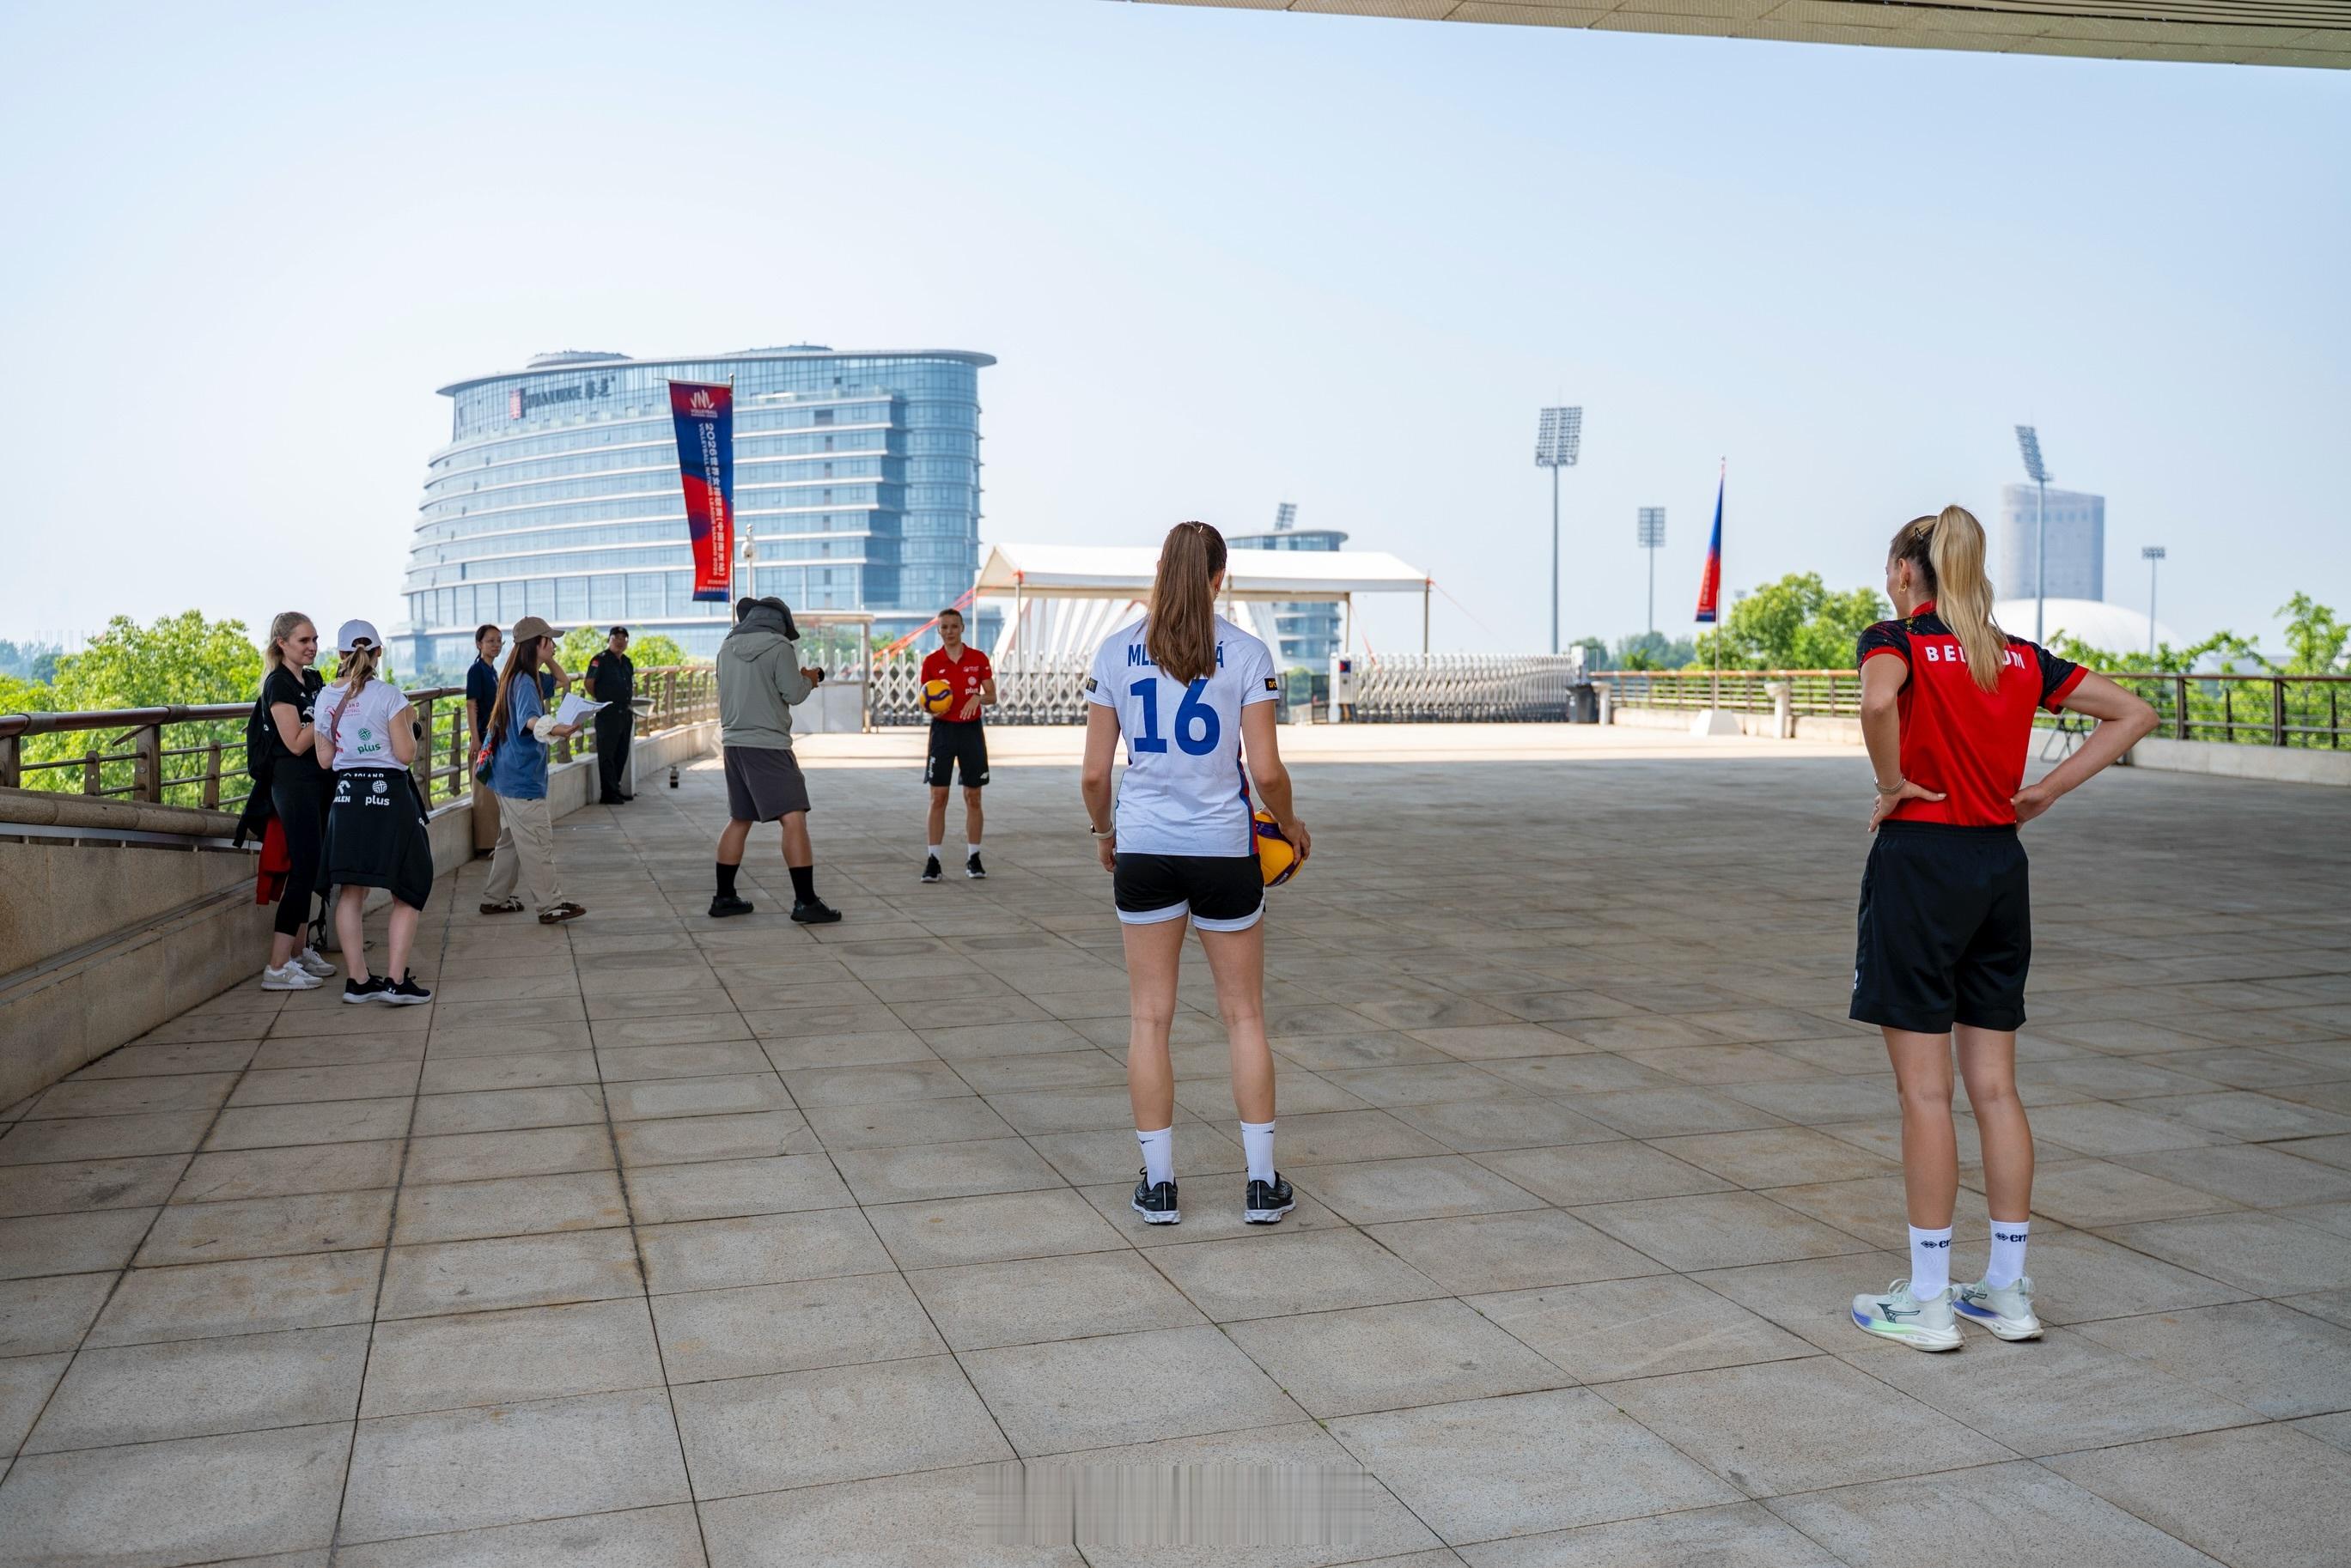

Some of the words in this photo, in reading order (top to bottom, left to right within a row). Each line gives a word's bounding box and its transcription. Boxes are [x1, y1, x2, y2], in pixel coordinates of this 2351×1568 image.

[1130, 678, 1221, 756] 16
[357, 743, 381, 754] plus
[365, 794, 390, 805] plus
